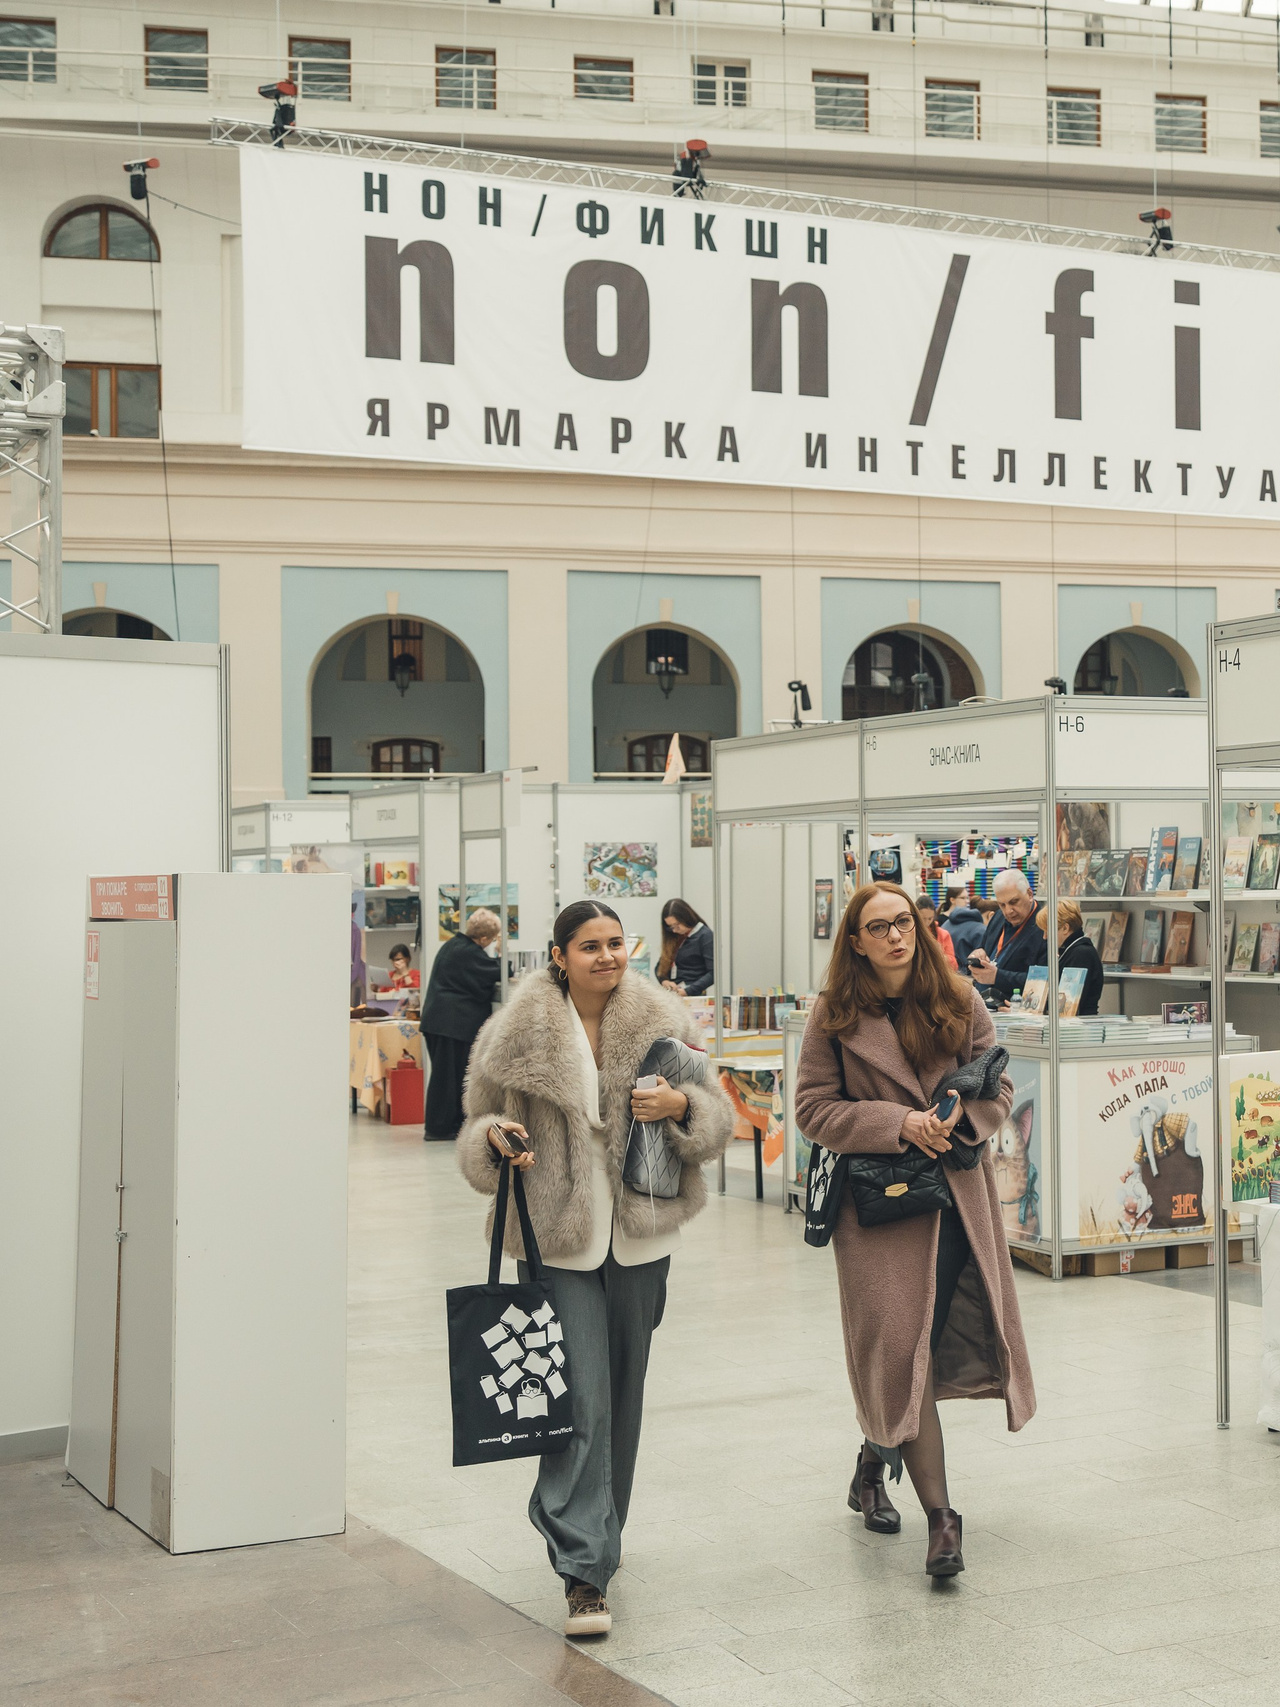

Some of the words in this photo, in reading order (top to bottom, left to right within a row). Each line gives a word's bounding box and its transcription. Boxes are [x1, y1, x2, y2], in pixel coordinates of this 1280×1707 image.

[363, 171, 829, 265] НОН/ФИКШН
[366, 397, 740, 464] ЯРМАРКА
[929, 743, 981, 767] ЭНАС-КНИГА
[1098, 1093, 1132, 1122] КОГДА
[1134, 1075, 1169, 1099] ПАПА
